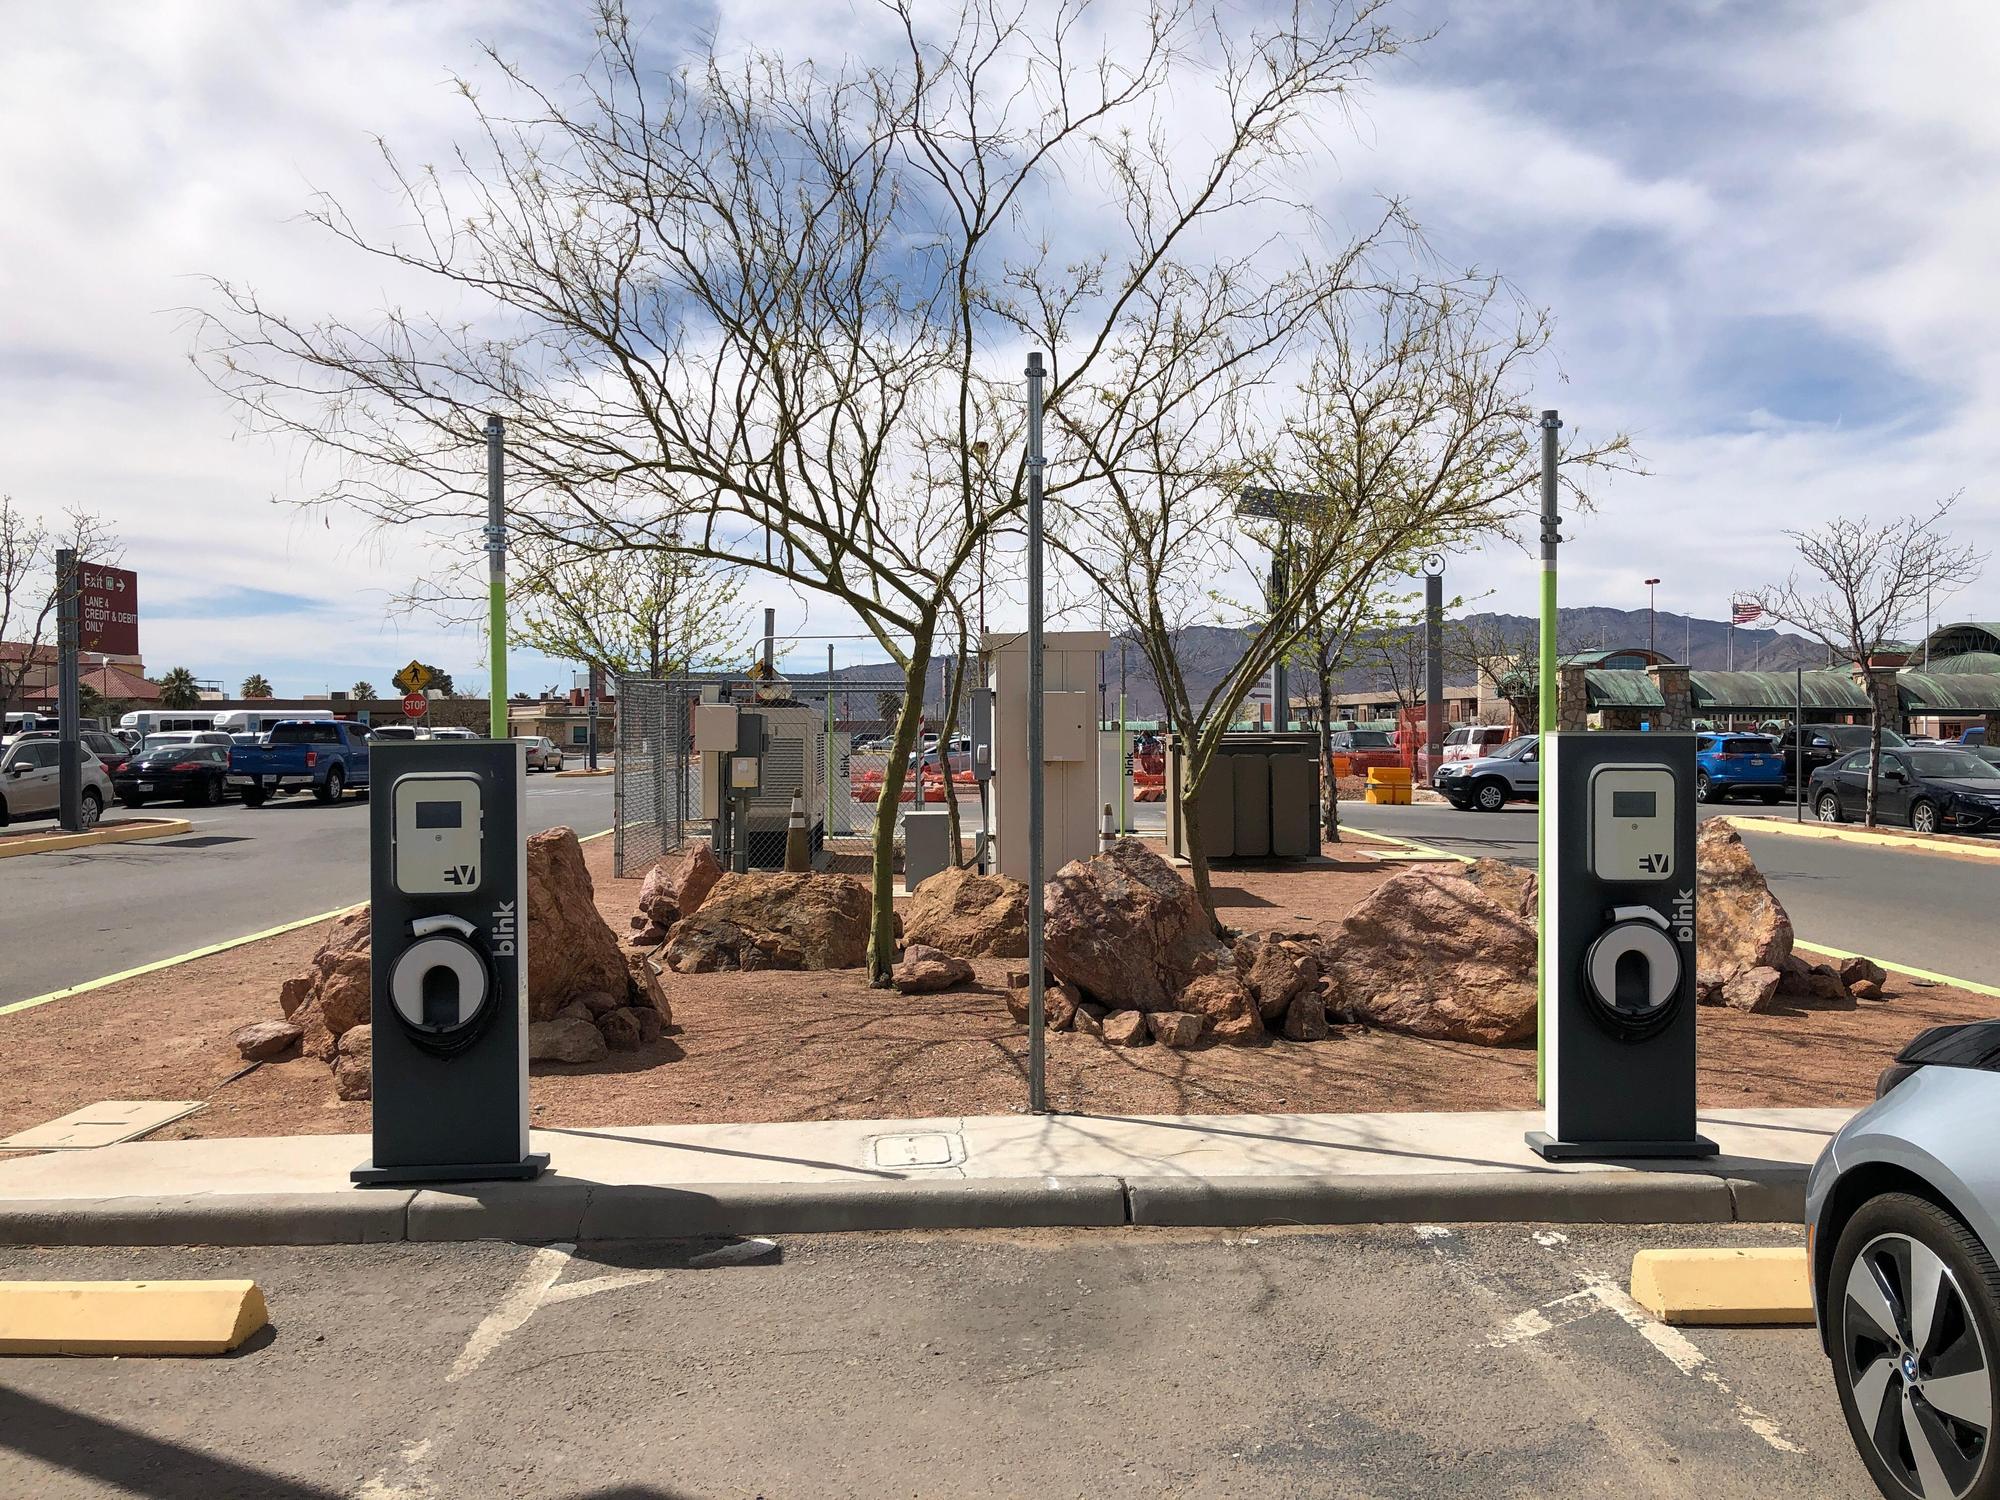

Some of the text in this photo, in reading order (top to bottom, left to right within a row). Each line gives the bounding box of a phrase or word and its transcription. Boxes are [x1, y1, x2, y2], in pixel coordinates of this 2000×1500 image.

[84, 572, 103, 589] Exit
[84, 595, 109, 608] LANE 4
[84, 607, 137, 624] CREDIT & DEBIT
[84, 620, 104, 633] ONLY
[405, 700, 425, 710] STOP
[839, 754, 850, 778] blink
[1124, 752, 1134, 777] blink
[1639, 853, 1669, 873] EV
[443, 865, 475, 885] EV
[1672, 888, 1693, 942] blink
[492, 900, 515, 957] blink
